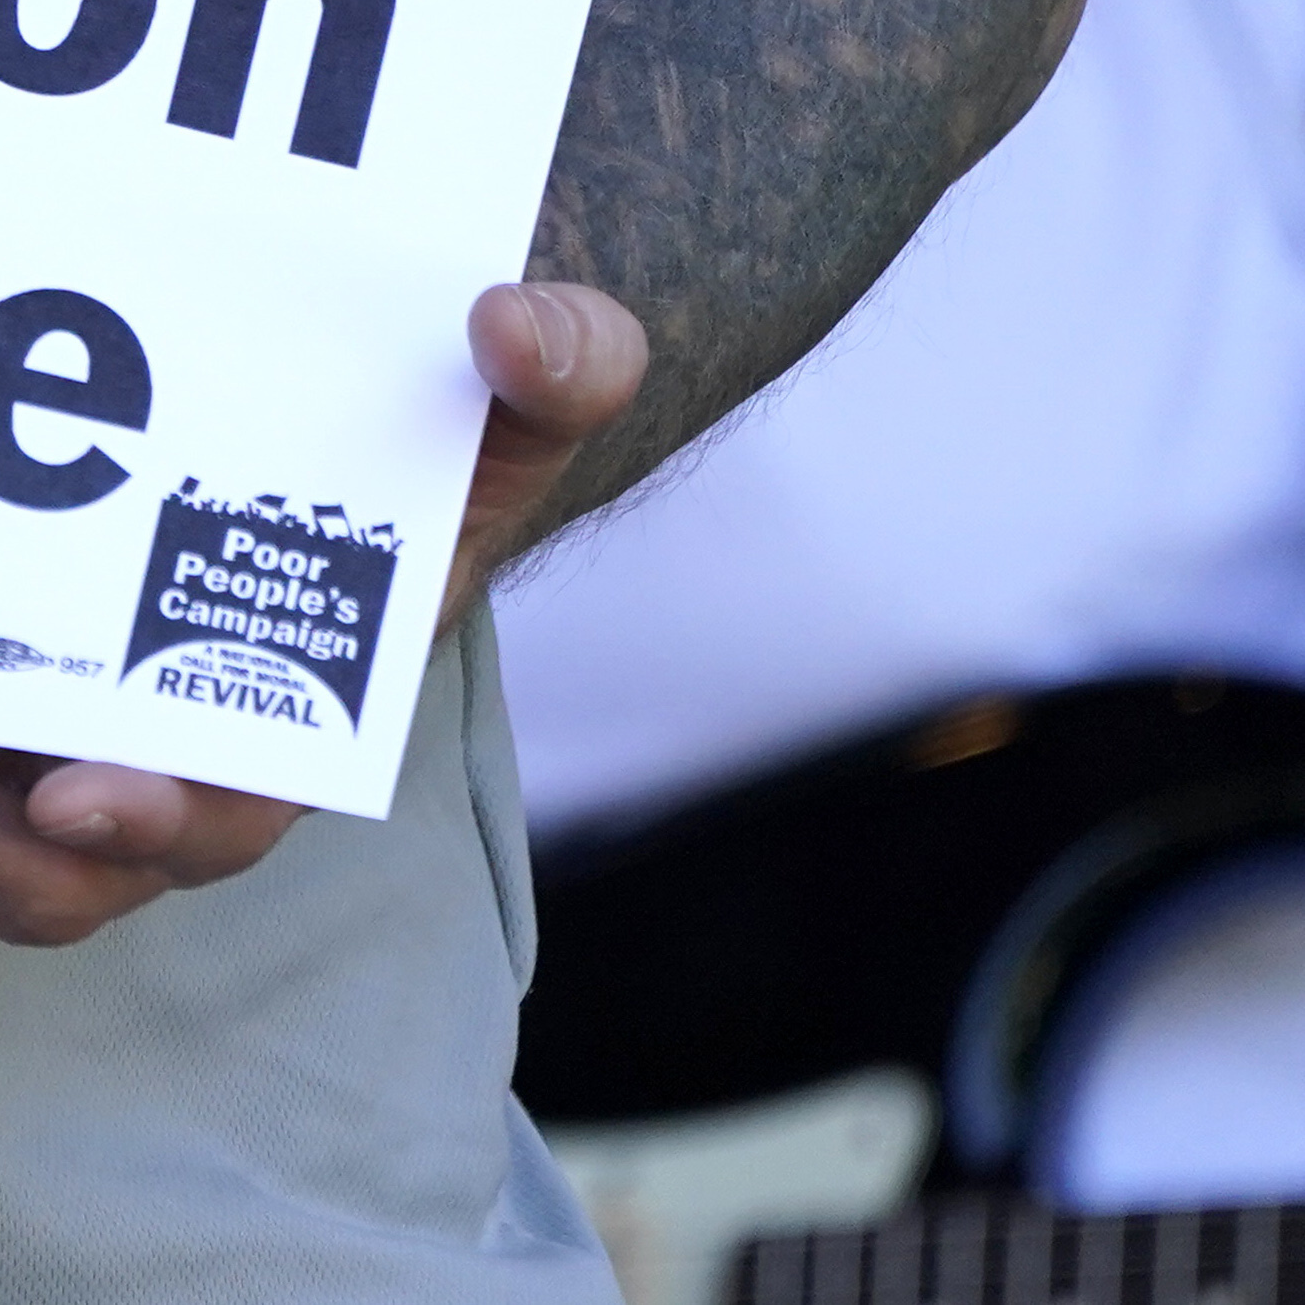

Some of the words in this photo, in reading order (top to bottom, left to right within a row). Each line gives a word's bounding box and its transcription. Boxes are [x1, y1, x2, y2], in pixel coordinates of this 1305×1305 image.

[222, 526, 332, 583] Poor
[172, 551, 362, 626] People's
[158, 587, 360, 662] Campaign
[58, 655, 105, 679] 957
[155, 665, 322, 730] REVIVAL
